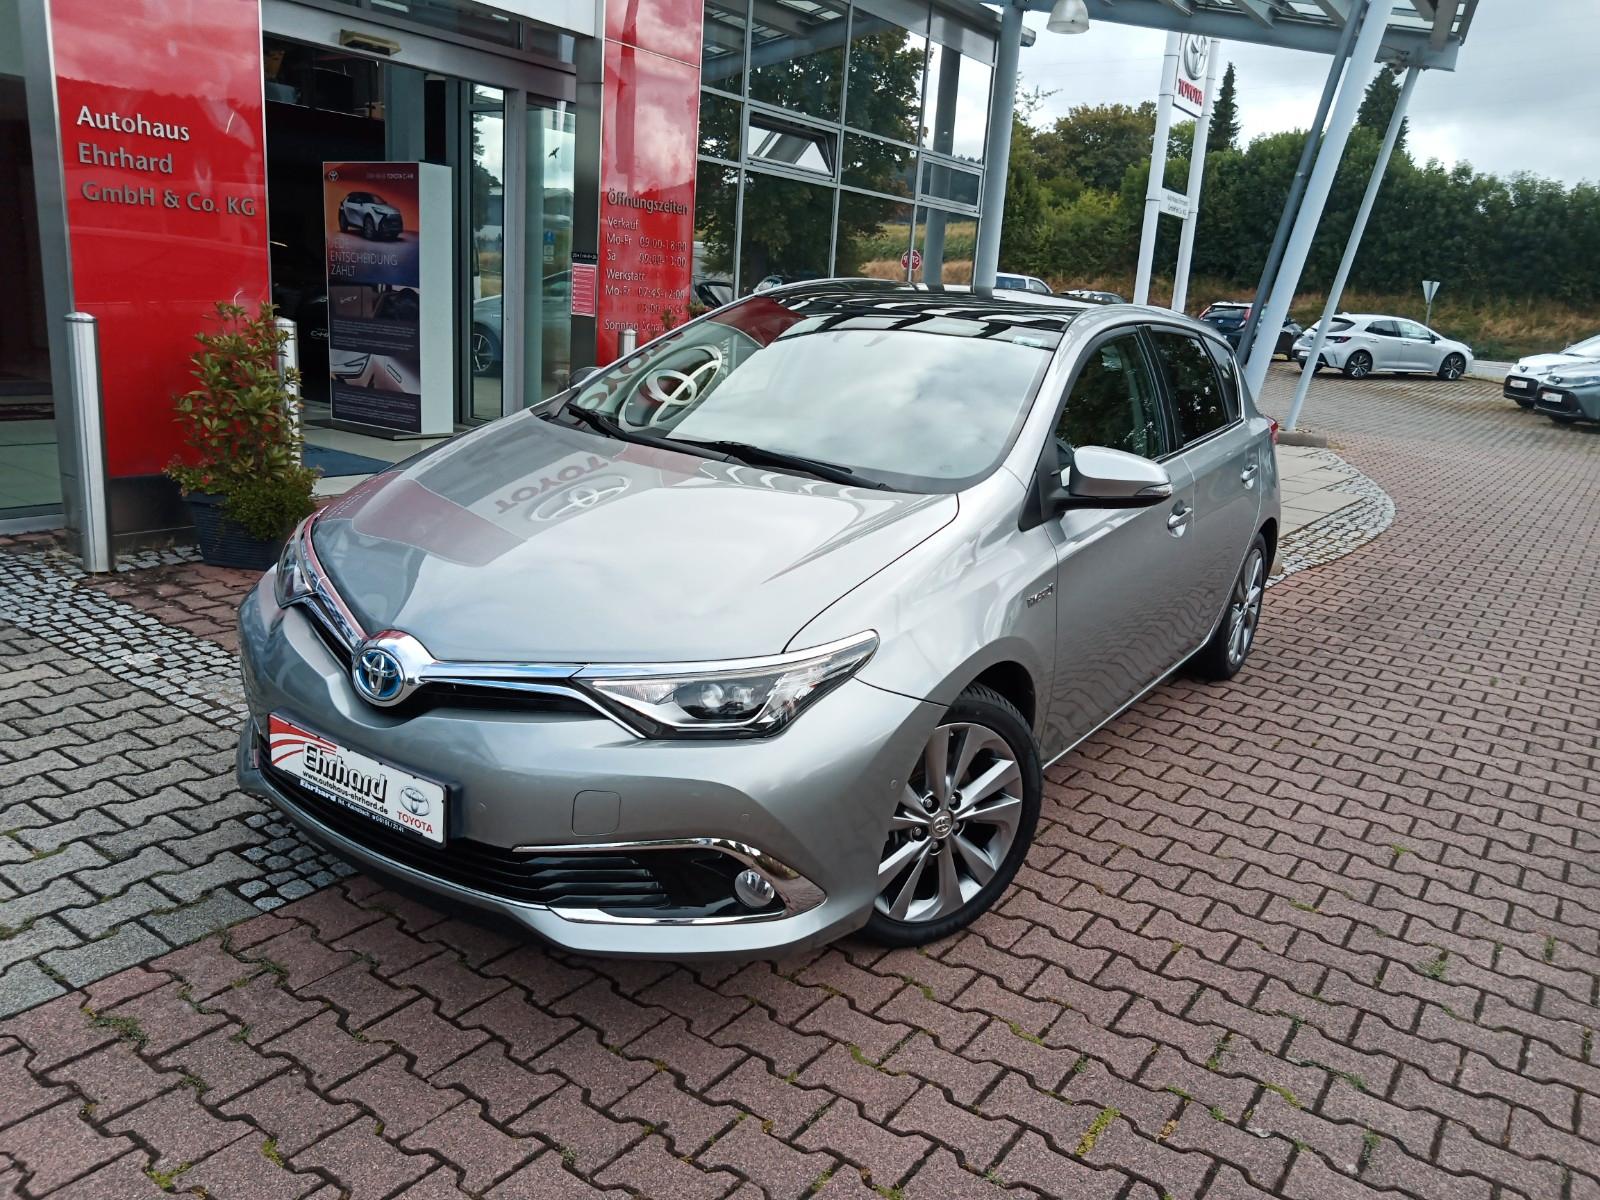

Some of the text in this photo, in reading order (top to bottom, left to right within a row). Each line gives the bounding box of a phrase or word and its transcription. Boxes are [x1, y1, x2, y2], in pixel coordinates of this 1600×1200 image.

[1178, 78, 1203, 107] TOYOTA
[76, 105, 190, 142] Autohaus
[78, 142, 173, 174] Ehrhard
[82, 180, 256, 216] GmbH & Co. KG
[607, 187, 689, 216] Öffnungszeiten
[607, 216, 639, 230] Verkauf
[606, 233, 632, 246] Mo-Fr
[330, 250, 398, 266] ENTSCHEIDUNG
[607, 249, 616, 261] Sa
[605, 268, 646, 282] Werkstatt
[605, 319, 639, 331] Sonntag
[303, 742, 388, 803] Ehrhard
[300, 779, 337, 802] Ehrhard
[302, 770, 389, 815] www.autohaus-ehrhard.de
[396, 811, 433, 834] TOYOTA
